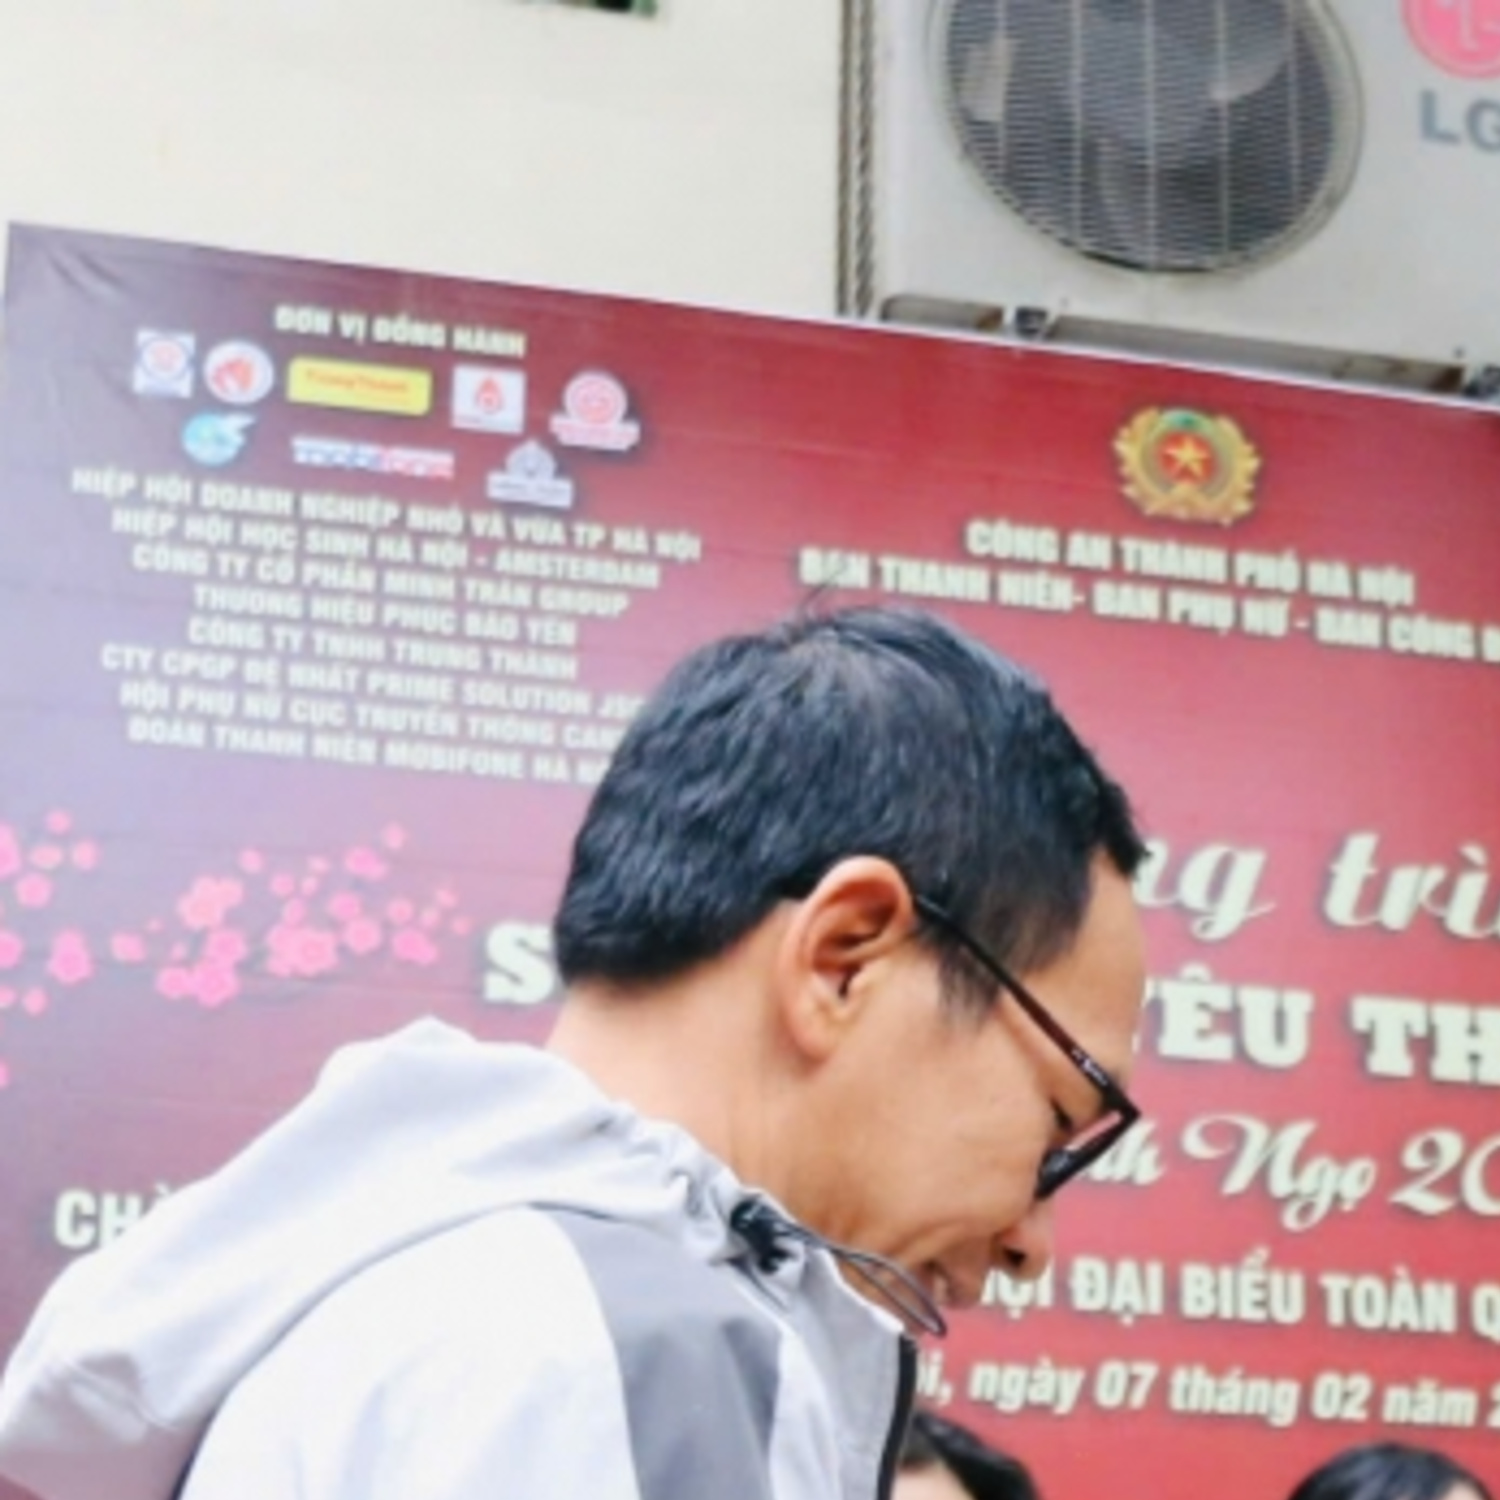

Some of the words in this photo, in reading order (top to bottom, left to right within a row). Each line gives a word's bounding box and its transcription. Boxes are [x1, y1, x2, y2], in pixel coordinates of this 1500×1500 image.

[202, 482, 293, 515] DOANH
[573, 523, 606, 548] TP
[966, 518, 1058, 563] CÔNG
[1066, 531, 1112, 571] AN
[216, 552, 250, 579] TY
[306, 528, 370, 558] SINH
[495, 547, 659, 589] AMSTERDAM
[800, 547, 870, 589] BAN
[878, 556, 990, 602] THANH
[1093, 581, 1160, 621] BAN
[1315, 605, 1382, 649] BAN
[1388, 614, 1476, 660] CÔNG
[101, 643, 154, 672] CTY
[272, 625, 305, 652] TY
[1144, 962, 1313, 1068] ÊU
[1069, 1255, 1165, 1325] ĐẠI
[1181, 1248, 1305, 1326] BIỂU
[1321, 1261, 1456, 1335] TOÀN
[970, 1354, 1084, 1414] ngày
[1096, 1361, 1159, 1409] 07
[1169, 1362, 1298, 1427] tháng
[1311, 1373, 1372, 1424] 02
[1382, 1383, 1478, 1429] năm
